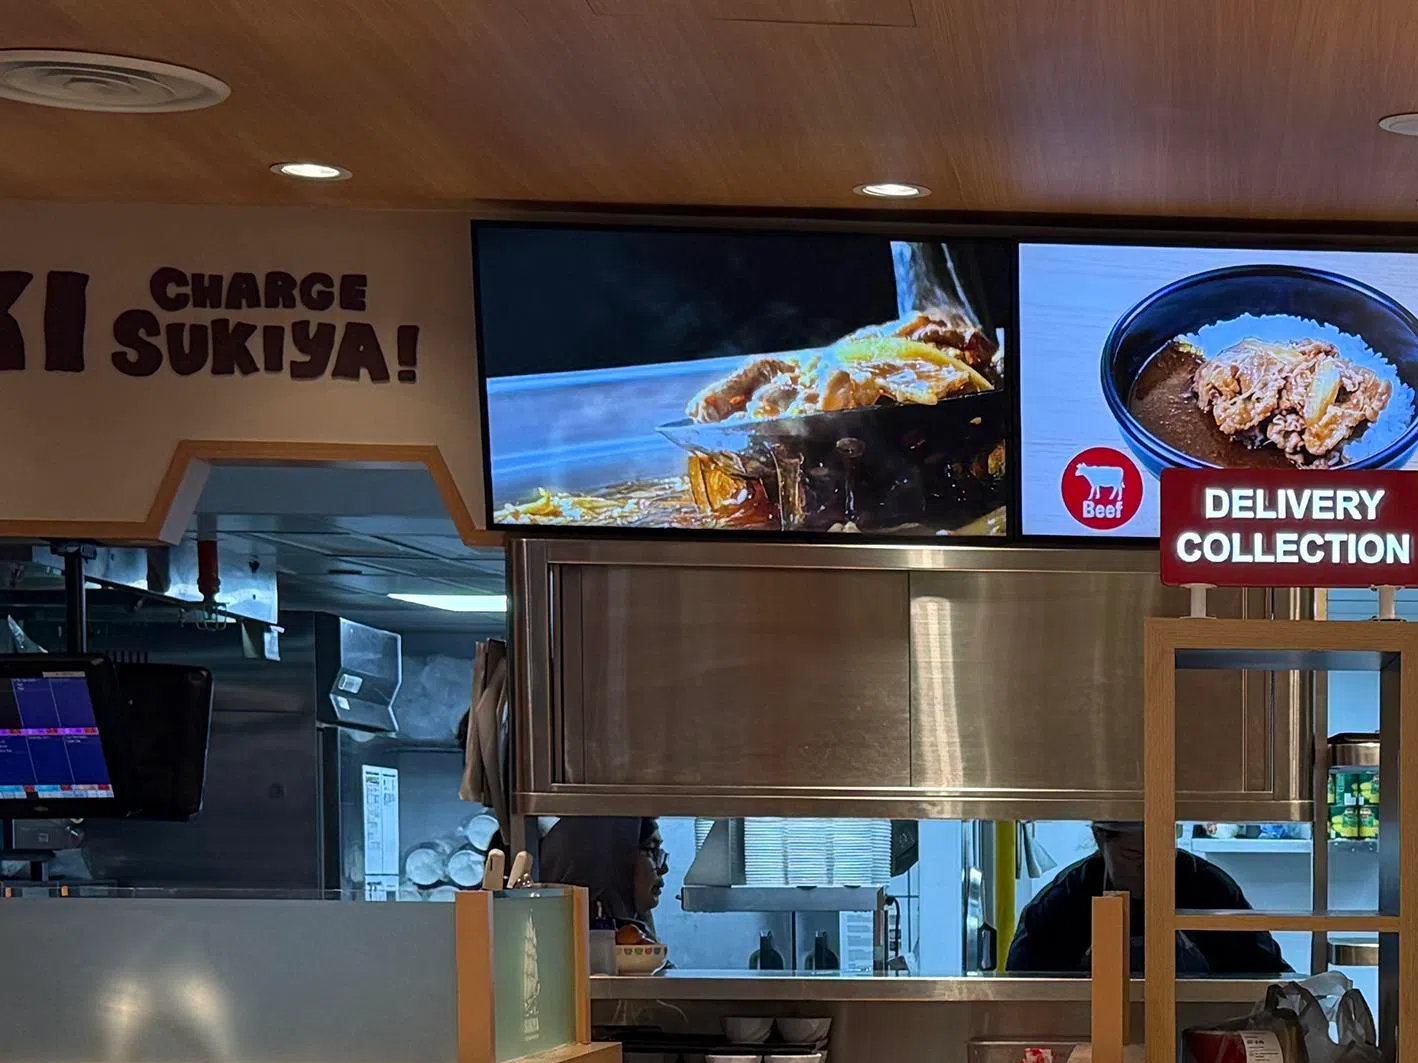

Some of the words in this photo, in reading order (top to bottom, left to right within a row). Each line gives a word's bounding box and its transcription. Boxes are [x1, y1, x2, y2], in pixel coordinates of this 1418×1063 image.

[150, 267, 368, 311] CHARGE
[111, 308, 420, 383] SUKIYA!
[1082, 500, 1124, 520] Beef
[1205, 489, 1386, 520] DELIVERY
[1176, 532, 1411, 565] COLLECTION
